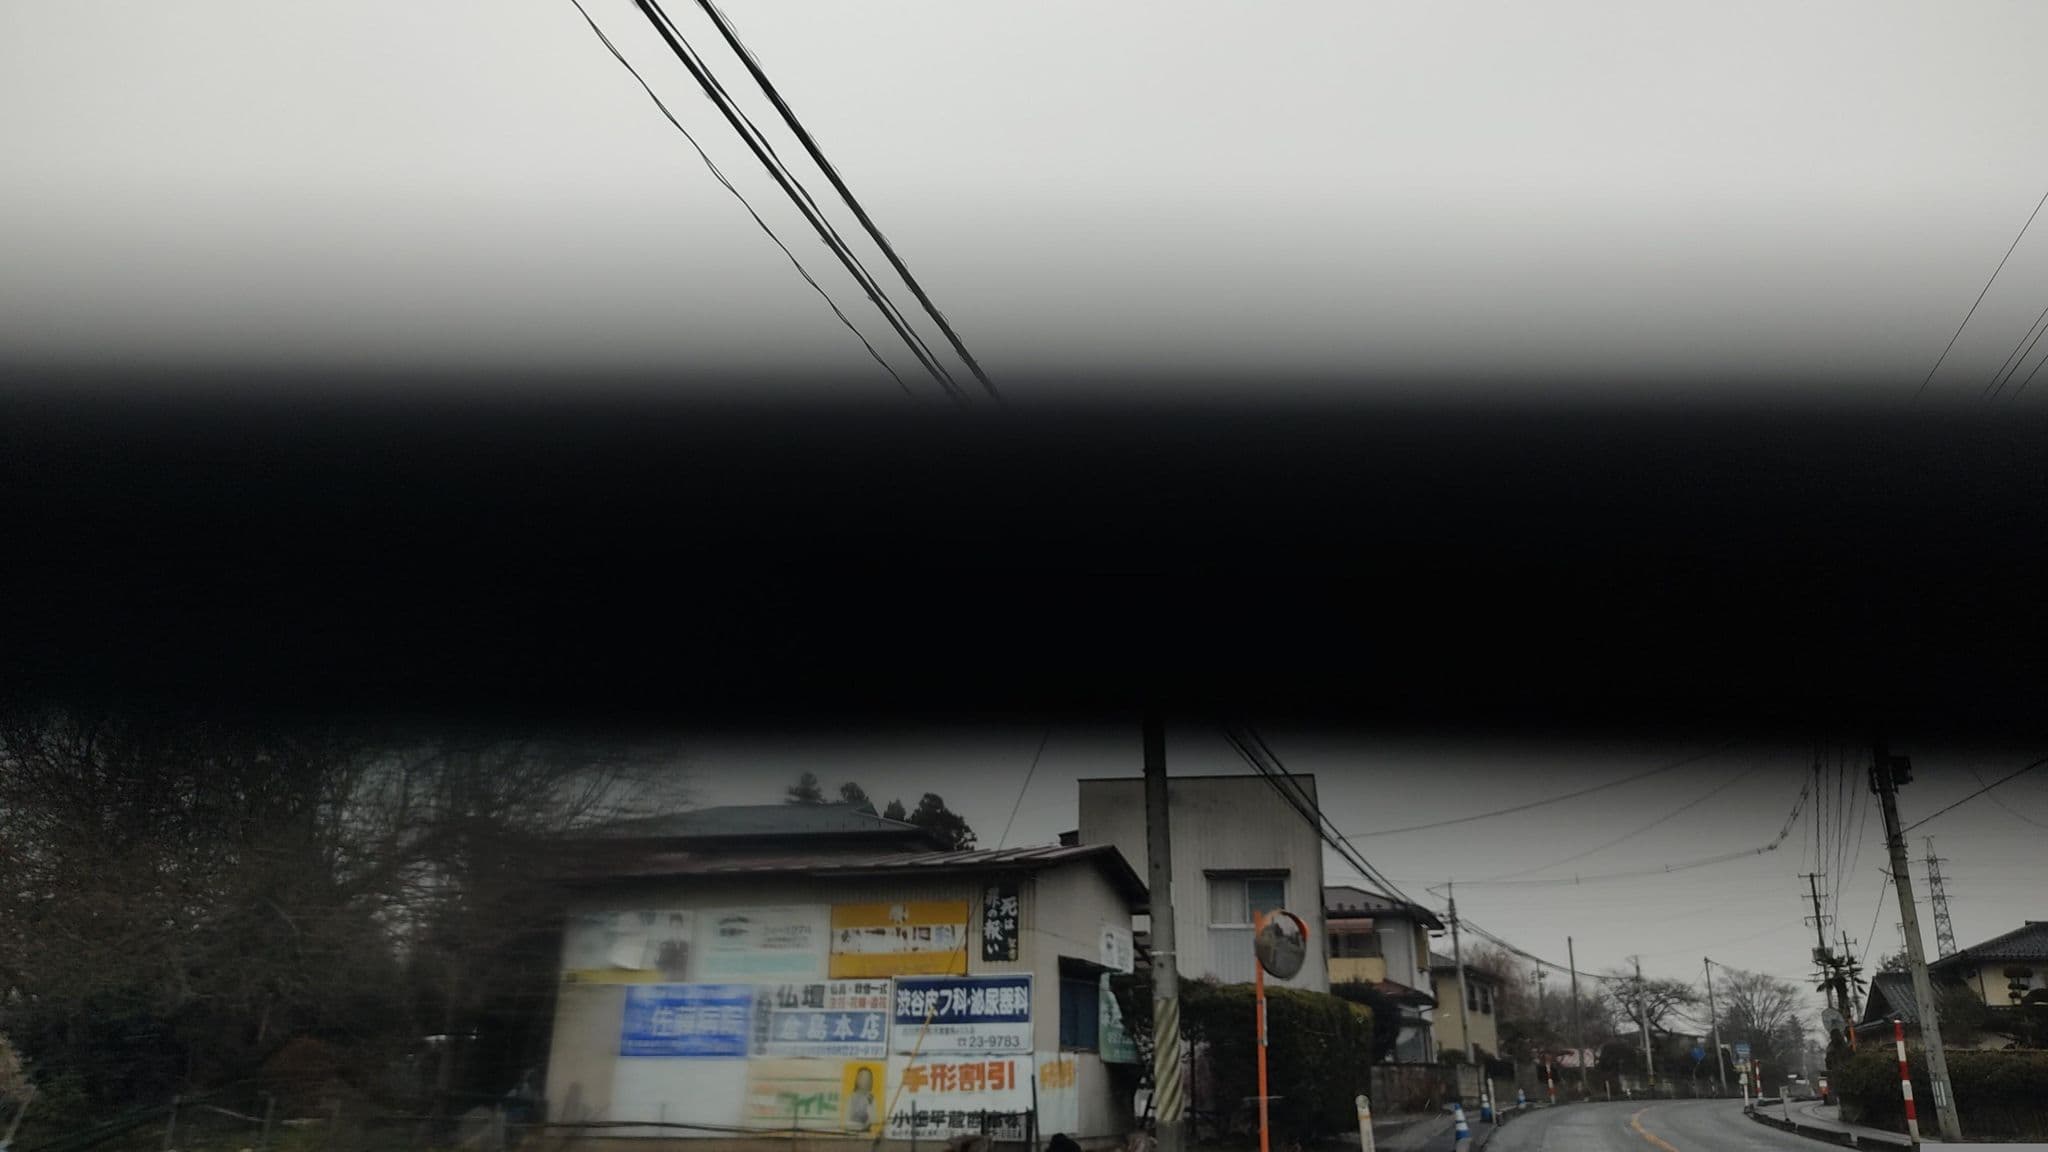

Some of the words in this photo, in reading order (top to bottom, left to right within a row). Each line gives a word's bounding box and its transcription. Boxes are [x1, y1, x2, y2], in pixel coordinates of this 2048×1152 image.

[776, 985, 825, 1008] 仏壇
[897, 986, 1028, 1016] 渋谷皮フ科・泌尿器科
[970, 1035, 1020, 1048] 23-9783
[903, 1061, 1015, 1093] 手形割引
